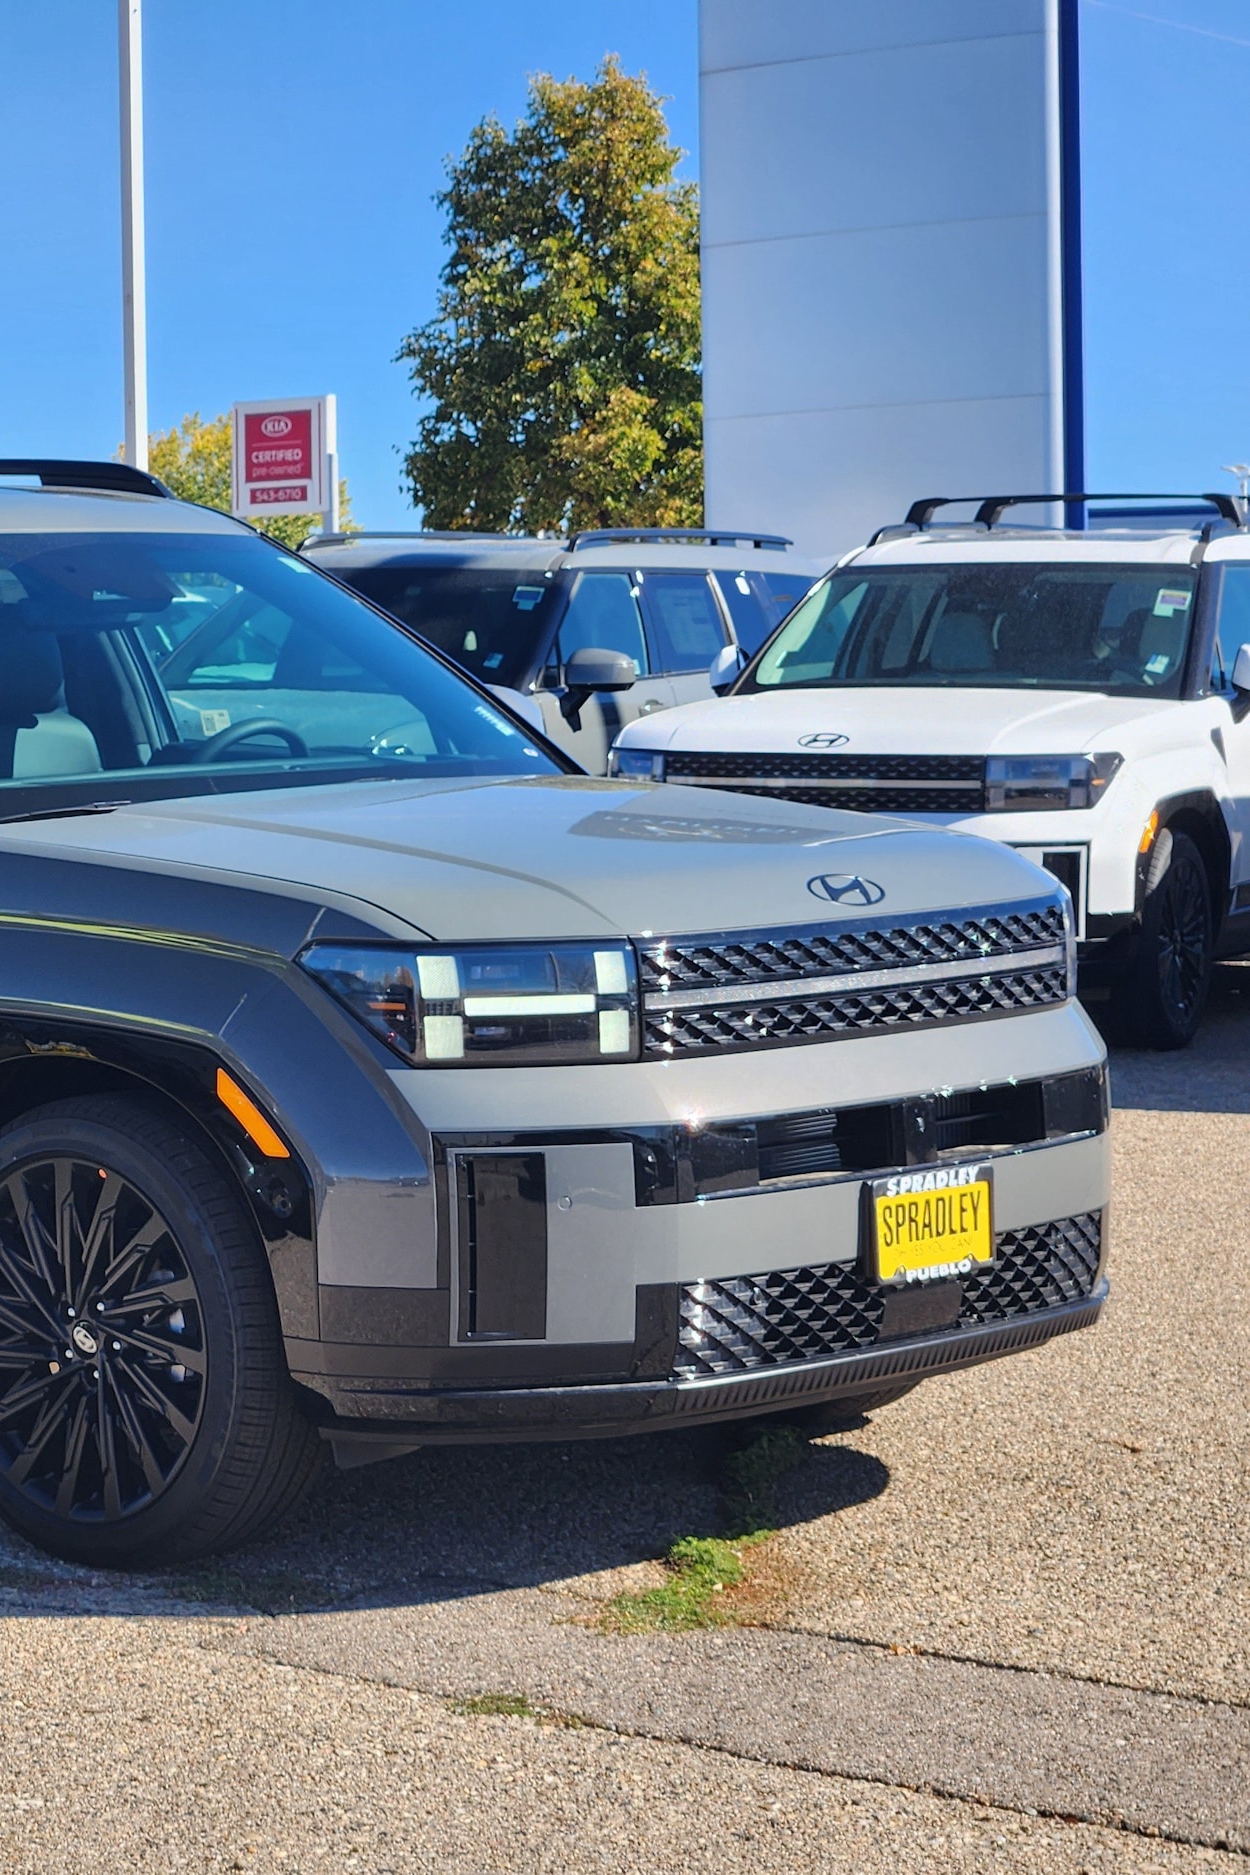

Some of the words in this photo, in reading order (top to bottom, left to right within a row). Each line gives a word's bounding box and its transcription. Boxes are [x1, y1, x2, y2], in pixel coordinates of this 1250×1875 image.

[266, 420, 288, 433] KIA
[251, 447, 302, 464] CERTIFIED
[886, 1165, 980, 1197] SPRADLEY
[882, 1190, 981, 1248] SPRADLEY
[906, 1258, 971, 1283] PUEBLO
